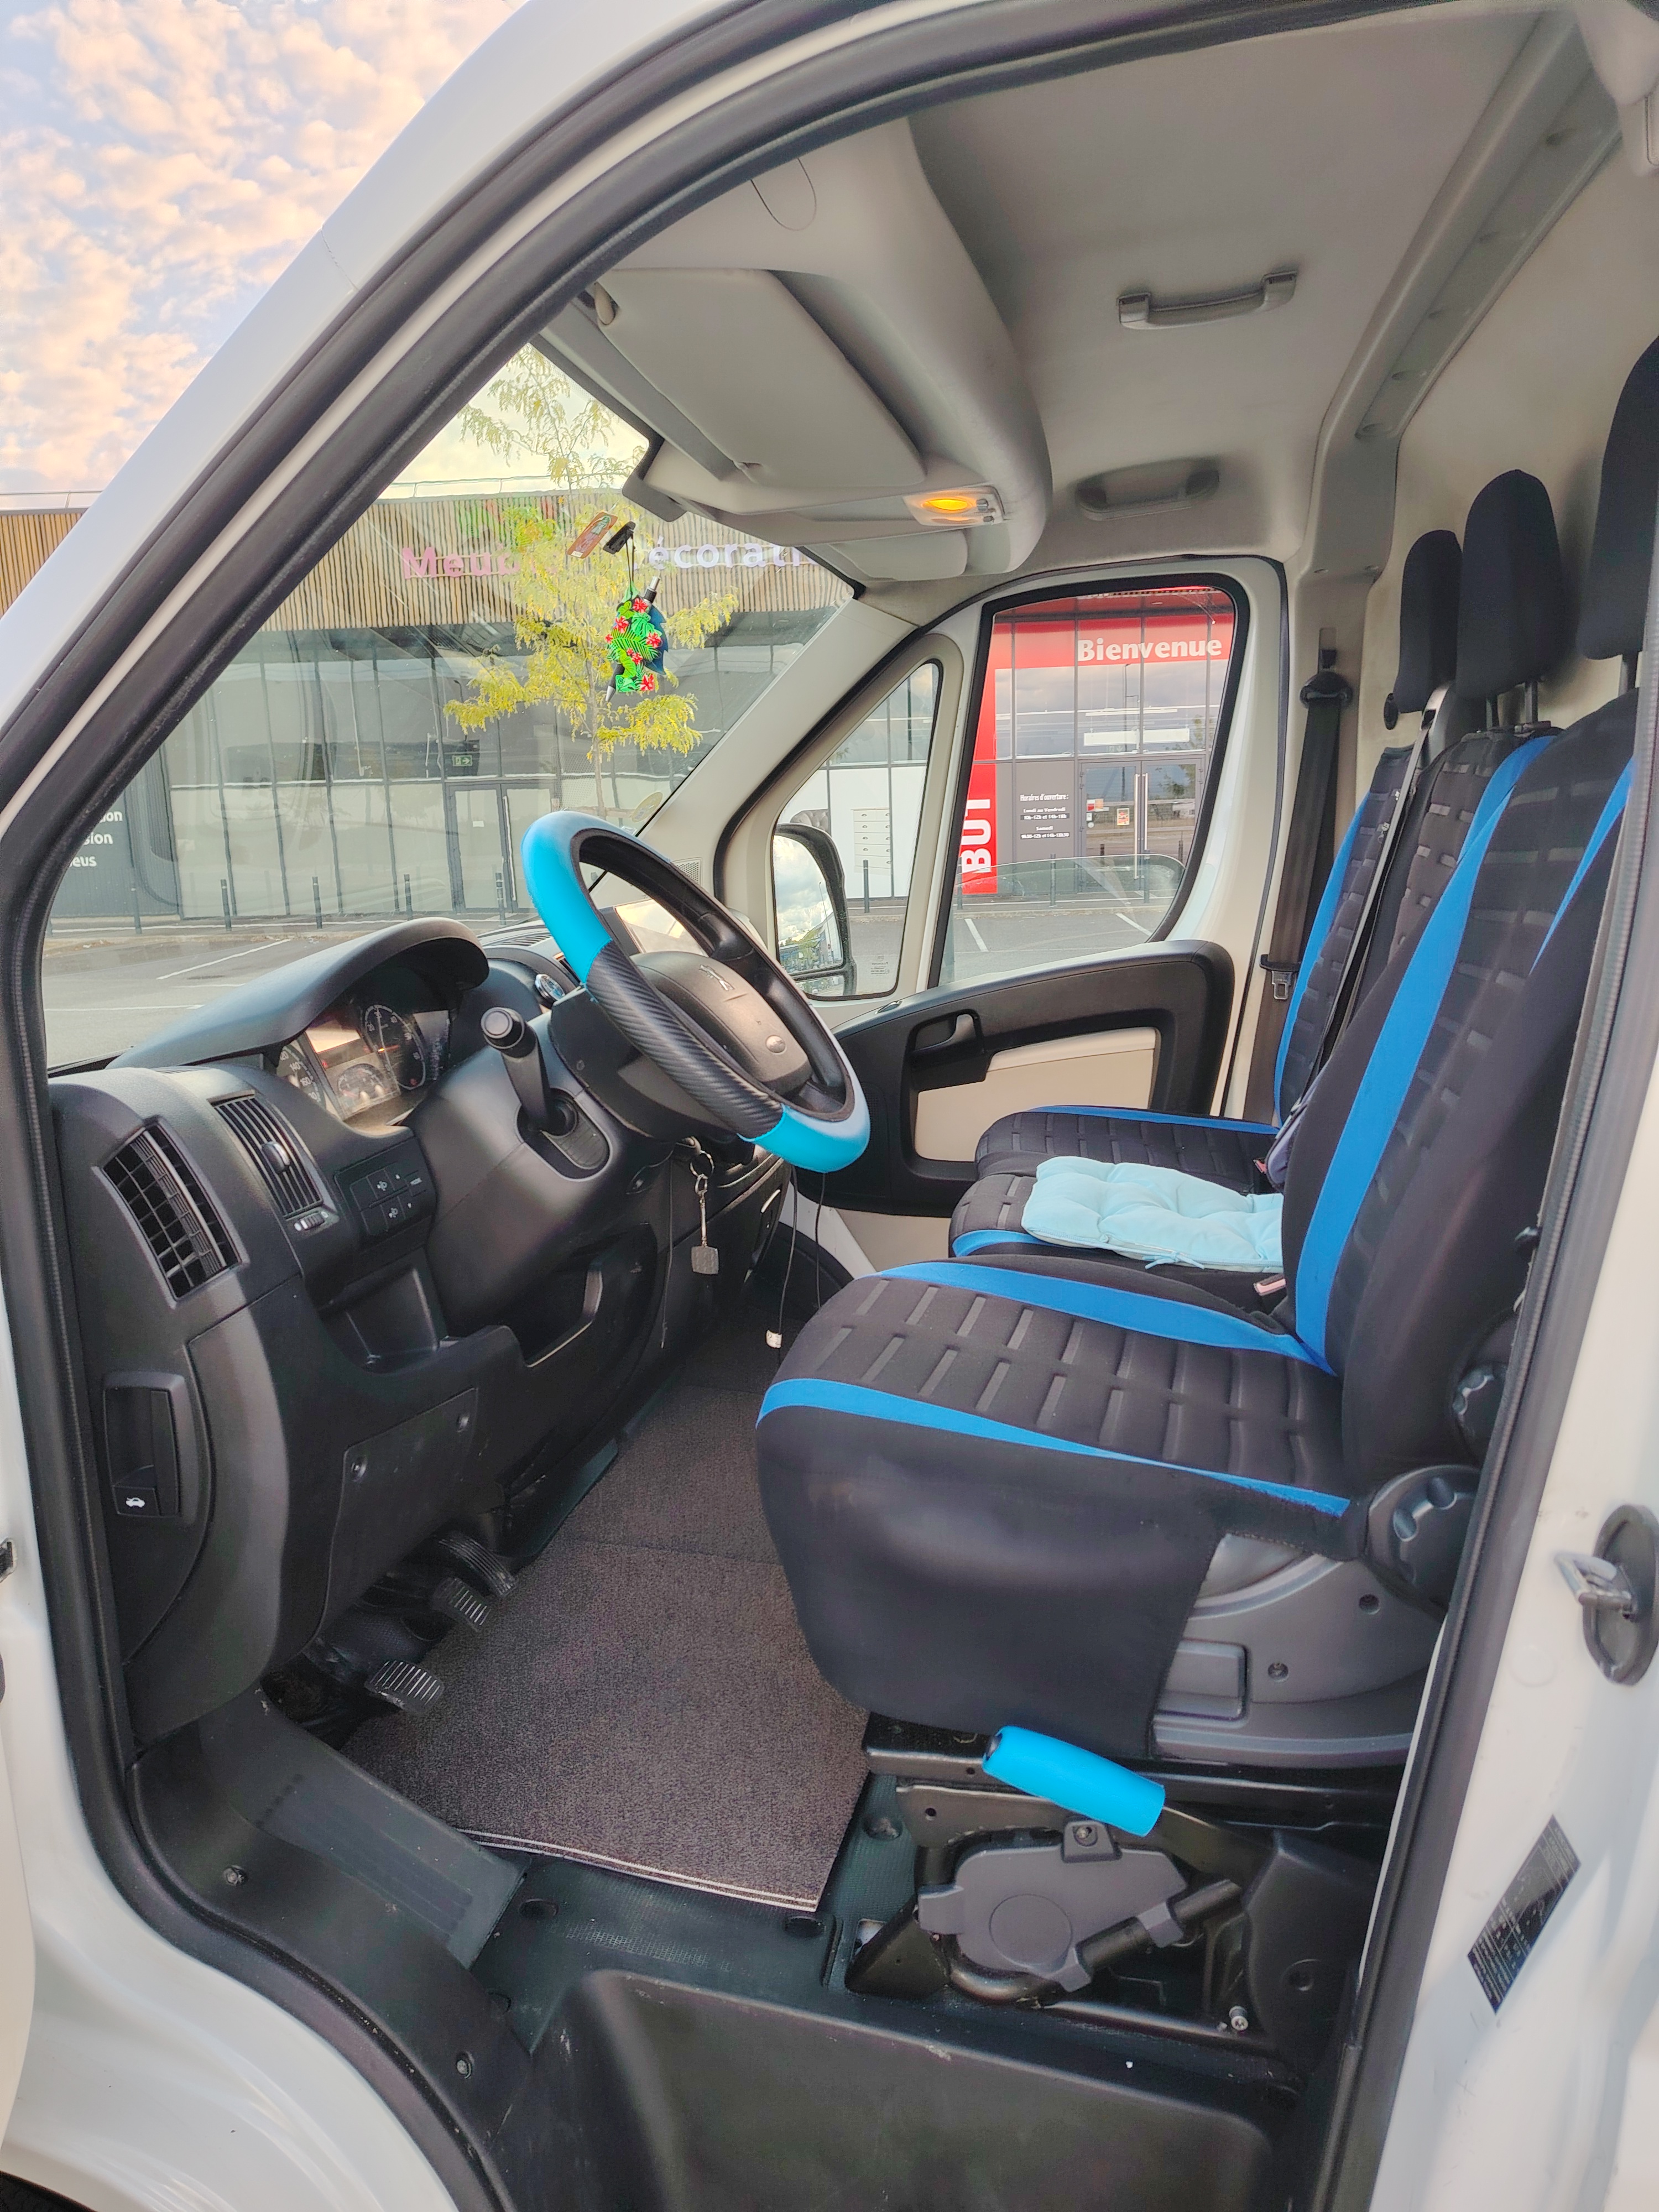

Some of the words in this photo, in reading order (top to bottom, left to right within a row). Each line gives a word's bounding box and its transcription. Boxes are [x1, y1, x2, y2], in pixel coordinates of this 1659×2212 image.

[1077, 638, 1222, 661] Bienvenue
[961, 799, 992, 874] BUT
[70, 856, 97, 867] eus
